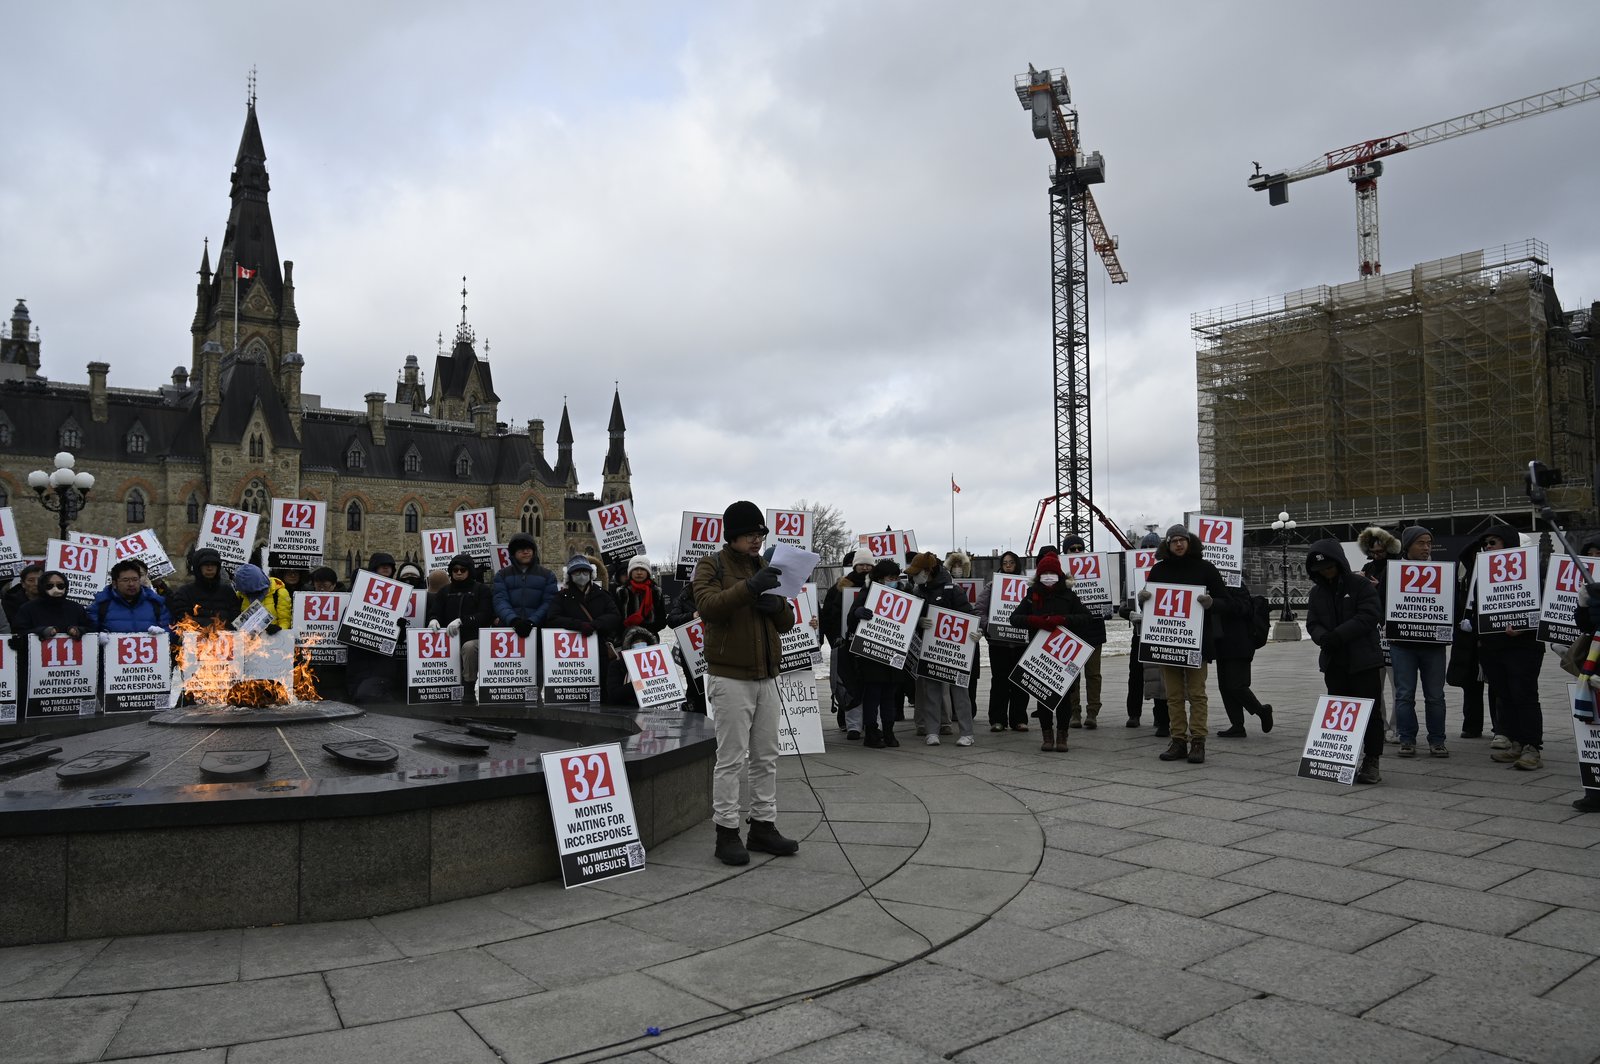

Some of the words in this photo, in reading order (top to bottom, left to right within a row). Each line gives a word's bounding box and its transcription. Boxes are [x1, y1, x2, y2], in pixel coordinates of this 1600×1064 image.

[216, 512, 244, 538] 42
[286, 502, 313, 528] 42
[466, 514, 485, 535] 38
[602, 507, 624, 529] 23
[779, 513, 800, 535] 29
[606, 527, 627, 536] MONTHS
[697, 518, 718, 542] 70
[1203, 519, 1229, 544] 72
[116, 537, 143, 556] 16
[433, 533, 450, 554] 27
[872, 535, 893, 556] 31
[63, 546, 93, 572] 30
[1070, 555, 1097, 580] 22
[1493, 551, 1522, 582] 33
[1404, 565, 1437, 593] 22
[1493, 584, 1522, 593] MONTHS
[369, 579, 396, 610] 51
[1158, 588, 1186, 617] 41
[1486, 593, 1514, 602] WAITING
[1498, 600, 1535, 609] RESPONSE
[307, 595, 337, 621] 34
[363, 606, 390, 618] MONTHS
[879, 591, 909, 621] 90
[347, 617, 362, 625] IRCC
[362, 621, 396, 635] RESPONSE
[354, 611, 381, 623] WAITING
[381, 619, 395, 627] FOR
[874, 617, 901, 631] MONTHS
[939, 612, 965, 642] 65
[1157, 619, 1186, 627] MONTHS
[860, 628, 874, 637] IRCC
[874, 633, 906, 648] RESPONSE
[866, 622, 892, 636] WAITING
[892, 631, 905, 640] FOR
[1149, 626, 1177, 634] WAITING
[1160, 635, 1196, 644] RESPONSE
[47, 638, 76, 667] 11
[122, 636, 154, 664] 35
[420, 632, 447, 658] 34
[494, 632, 521, 658] 31
[558, 632, 584, 658] 34
[783, 639, 814, 651] RESPONSE
[928, 646, 953, 657] WAITING
[936, 640, 961, 651] MONTHS
[1048, 633, 1077, 663] 40
[641, 650, 665, 677] 42
[788, 658, 810, 667] RESULTS
[923, 652, 937, 660] IRCC
[937, 656, 968, 668] RESPONSE
[1031, 656, 1053, 675] WAITING
[1053, 671, 1064, 683] FOR
[1039, 653, 1063, 672] MONTHS
[645, 678, 668, 687] MONTHS
[1023, 660, 1035, 671] IRCC
[1034, 668, 1064, 692] RESPONSE
[641, 686, 664, 696] WAITING
[653, 691, 681, 701] RESPONSE
[1028, 684, 1047, 700] RESULTS
[1030, 677, 1052, 696] TIMELINES
[790, 706, 819, 717] suspens.
[1325, 700, 1356, 731] 36
[1313, 740, 1339, 749] WAITING
[1321, 732, 1348, 742] MONTHS
[1321, 750, 1354, 760] RESPONSE
[568, 754, 610, 800] 32
[574, 802, 613, 818] MONTHS
[567, 817, 605, 834] WAITING
[607, 813, 625, 826] FOR
[564, 835, 585, 848] IRCC
[585, 825, 632, 844] RESPONSE
[576, 854, 588, 865] NO
[588, 846, 627, 862] TIMELINES
[582, 865, 593, 875] NO
[594, 857, 626, 872] RESULTS
